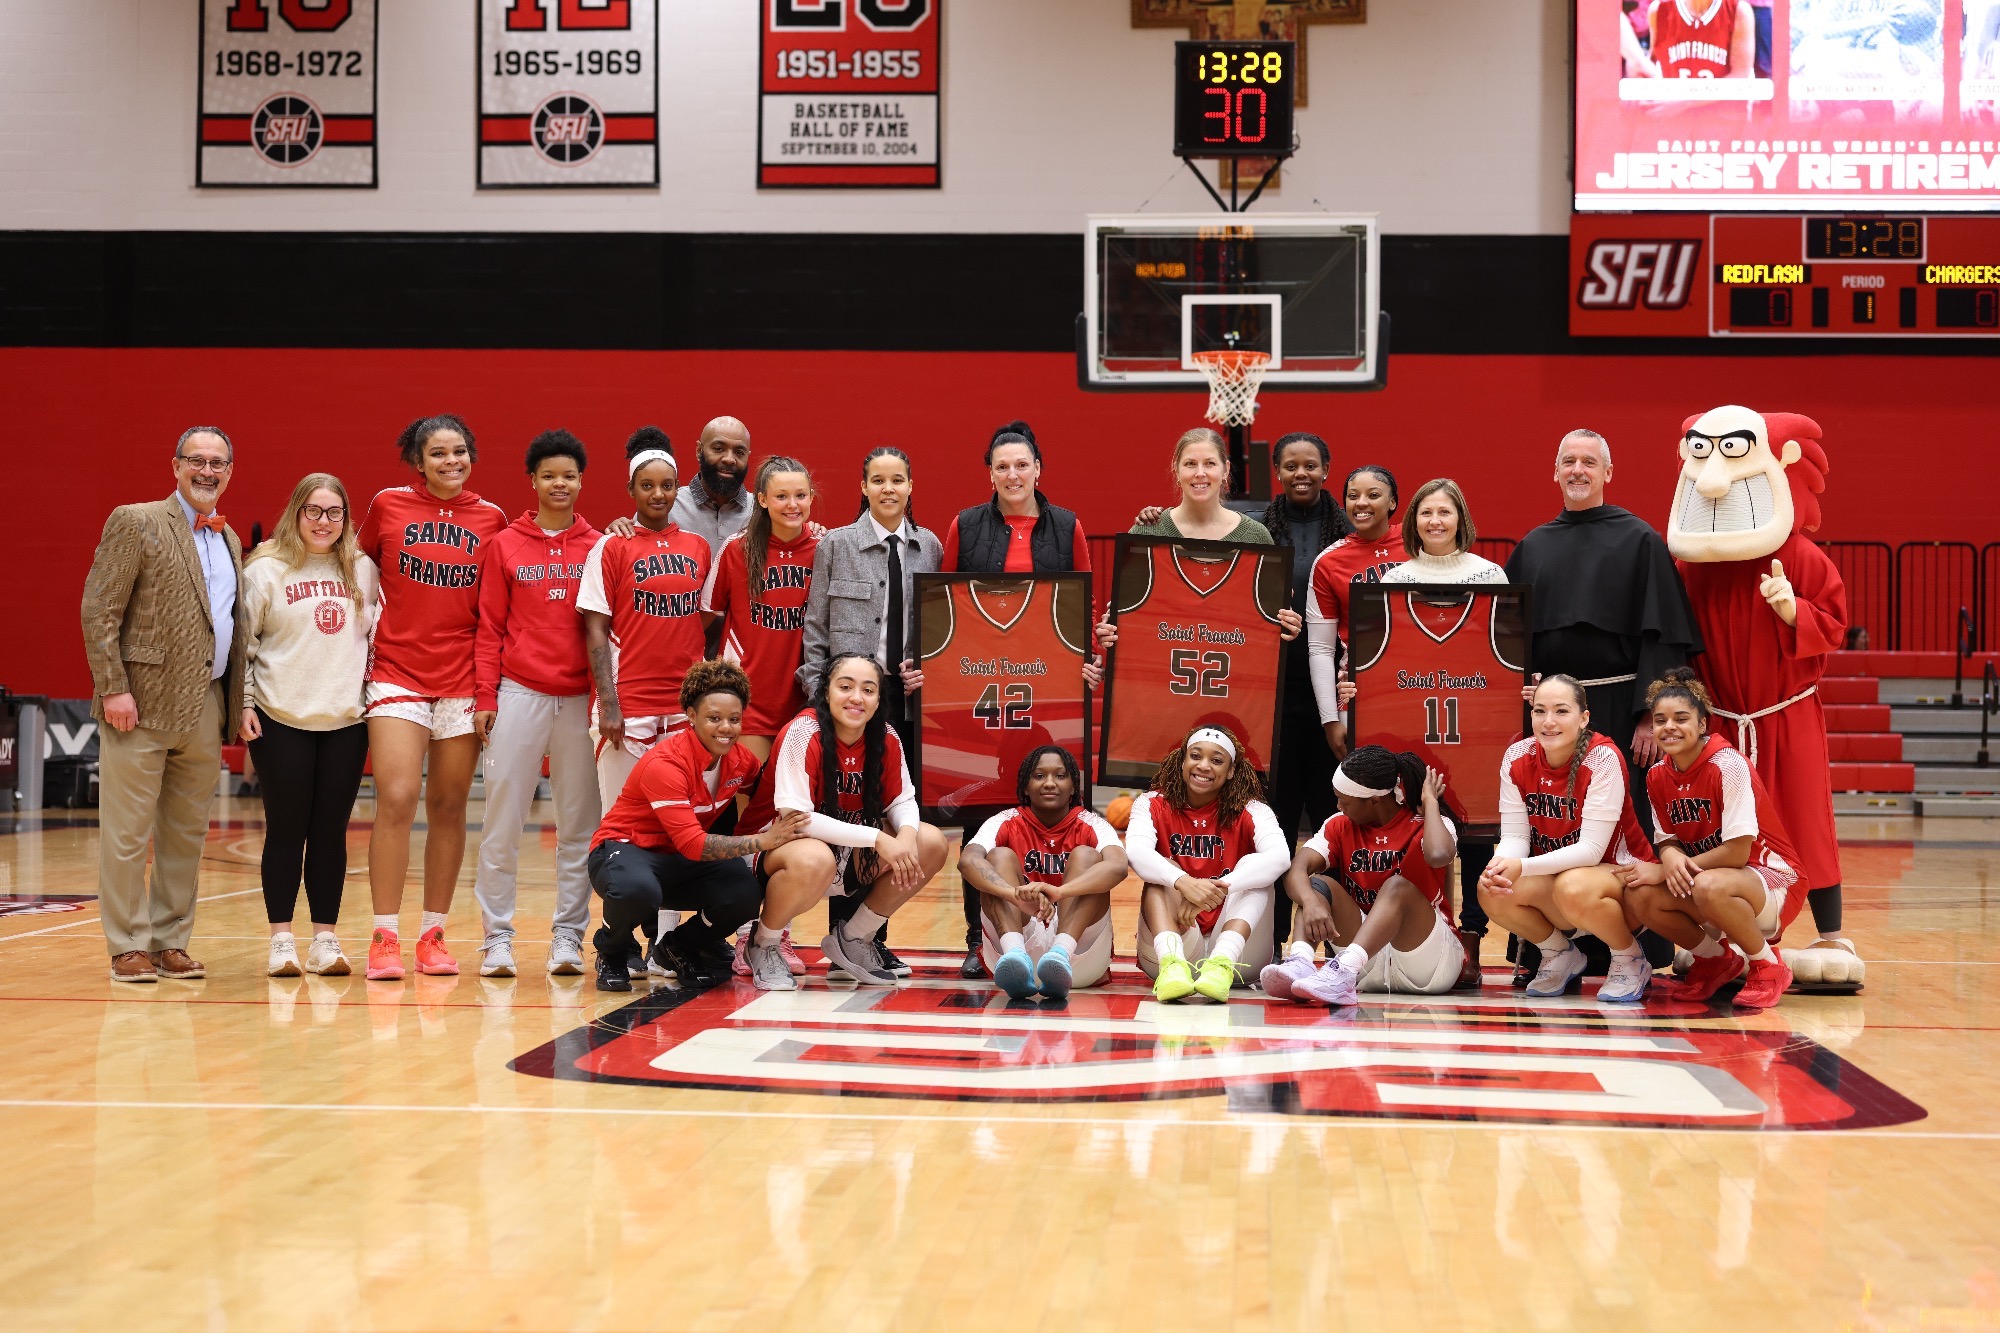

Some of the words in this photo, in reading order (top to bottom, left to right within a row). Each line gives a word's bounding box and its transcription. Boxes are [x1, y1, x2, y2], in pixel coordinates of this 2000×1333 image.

[215, 51, 362, 77] 1968-1972
[494, 50, 642, 76] 1965-1969
[776, 50, 921, 79] 1951-1955
[1199, 51, 1282, 83] 13:28
[795, 103, 904, 118] BASKETBALL
[1204, 88, 1267, 143] 30
[265, 116, 311, 143] SFU
[544, 115, 590, 142] SFU
[790, 123, 833, 138] HALL
[839, 123, 859, 138] OF
[865, 123, 909, 138] FAME
[781, 143, 858, 156] SEPTEMBER
[883, 143, 918, 156] 2004
[1596, 153, 1788, 189] JERSEY
[1825, 221, 1919, 257] 13:28
[1580, 241, 1699, 306] SFU
[1841, 275, 1885, 289] PERIOD
[1925, 265, 2000, 284] CHARGERS
[1866, 295, 1874, 320] 1
[404, 521, 481, 557] SAINT
[399, 550, 479, 589] FRANCIS
[516, 564, 546, 582] RED
[547, 563, 585, 580] FLAS
[633, 553, 699, 584] SAINT
[285, 580, 319, 606] SAINT
[548, 588, 567, 600] SFU
[1158, 621, 1196, 643] Saint
[1197, 623, 1247, 647] Francis
[960, 656, 998, 677] Saint
[999, 656, 1048, 677] Francis
[1169, 648, 1231, 699] 52
[1397, 669, 1436, 690] Saint
[1437, 669, 1488, 691] Francis
[972, 682, 1033, 730] 42
[1423, 696, 1462, 745] 11
[1666, 797, 1712, 825] AINT
